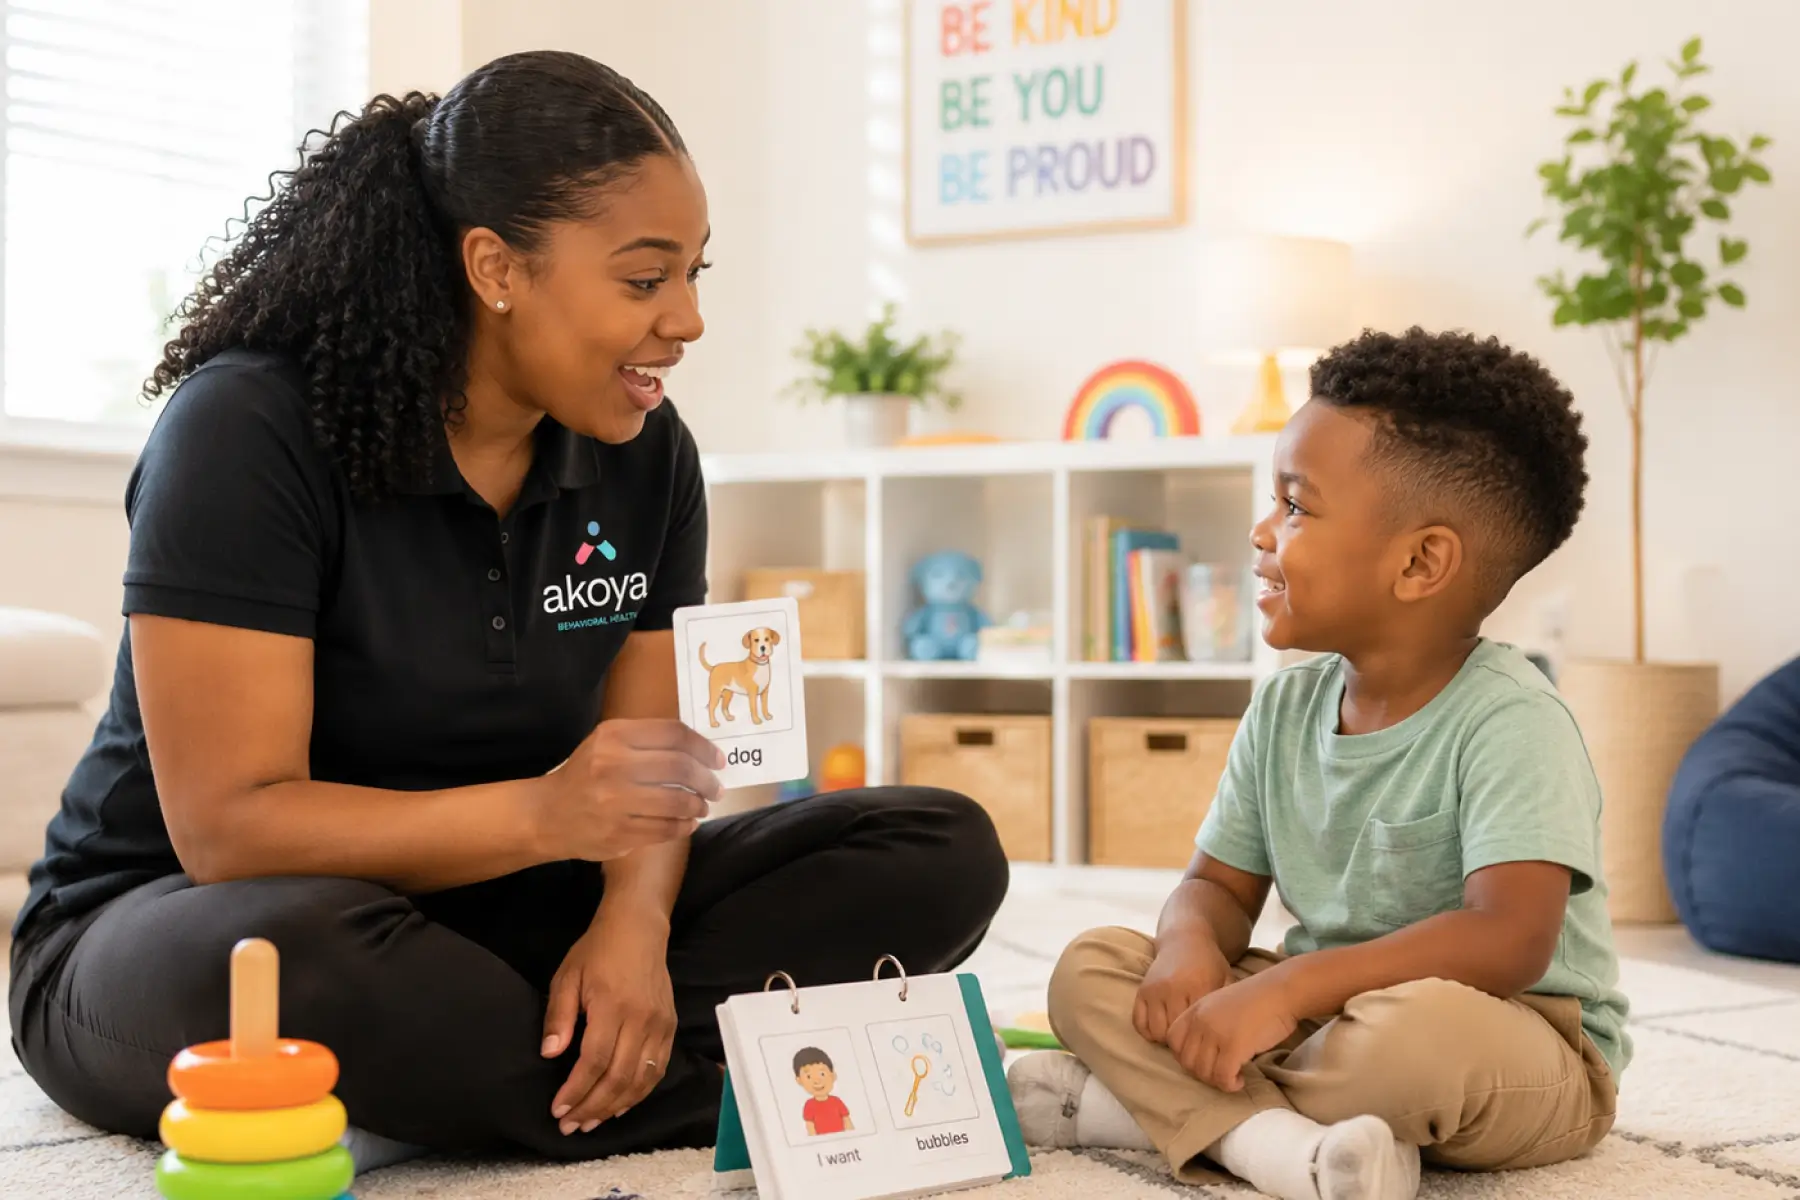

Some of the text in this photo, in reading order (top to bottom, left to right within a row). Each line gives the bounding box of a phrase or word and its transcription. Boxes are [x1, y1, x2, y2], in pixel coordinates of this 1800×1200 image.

[940, 0, 1119, 57] BE KIND
[940, 64, 1104, 131] BE YOU
[940, 136, 1157, 205] BE PROUD
[543, 572, 648, 613] akoya
[557, 616, 609, 631] BEHAVIORAL
[727, 747, 763, 766] dog
[916, 1132, 969, 1150] bubbles
[816, 1148, 862, 1168] I want
